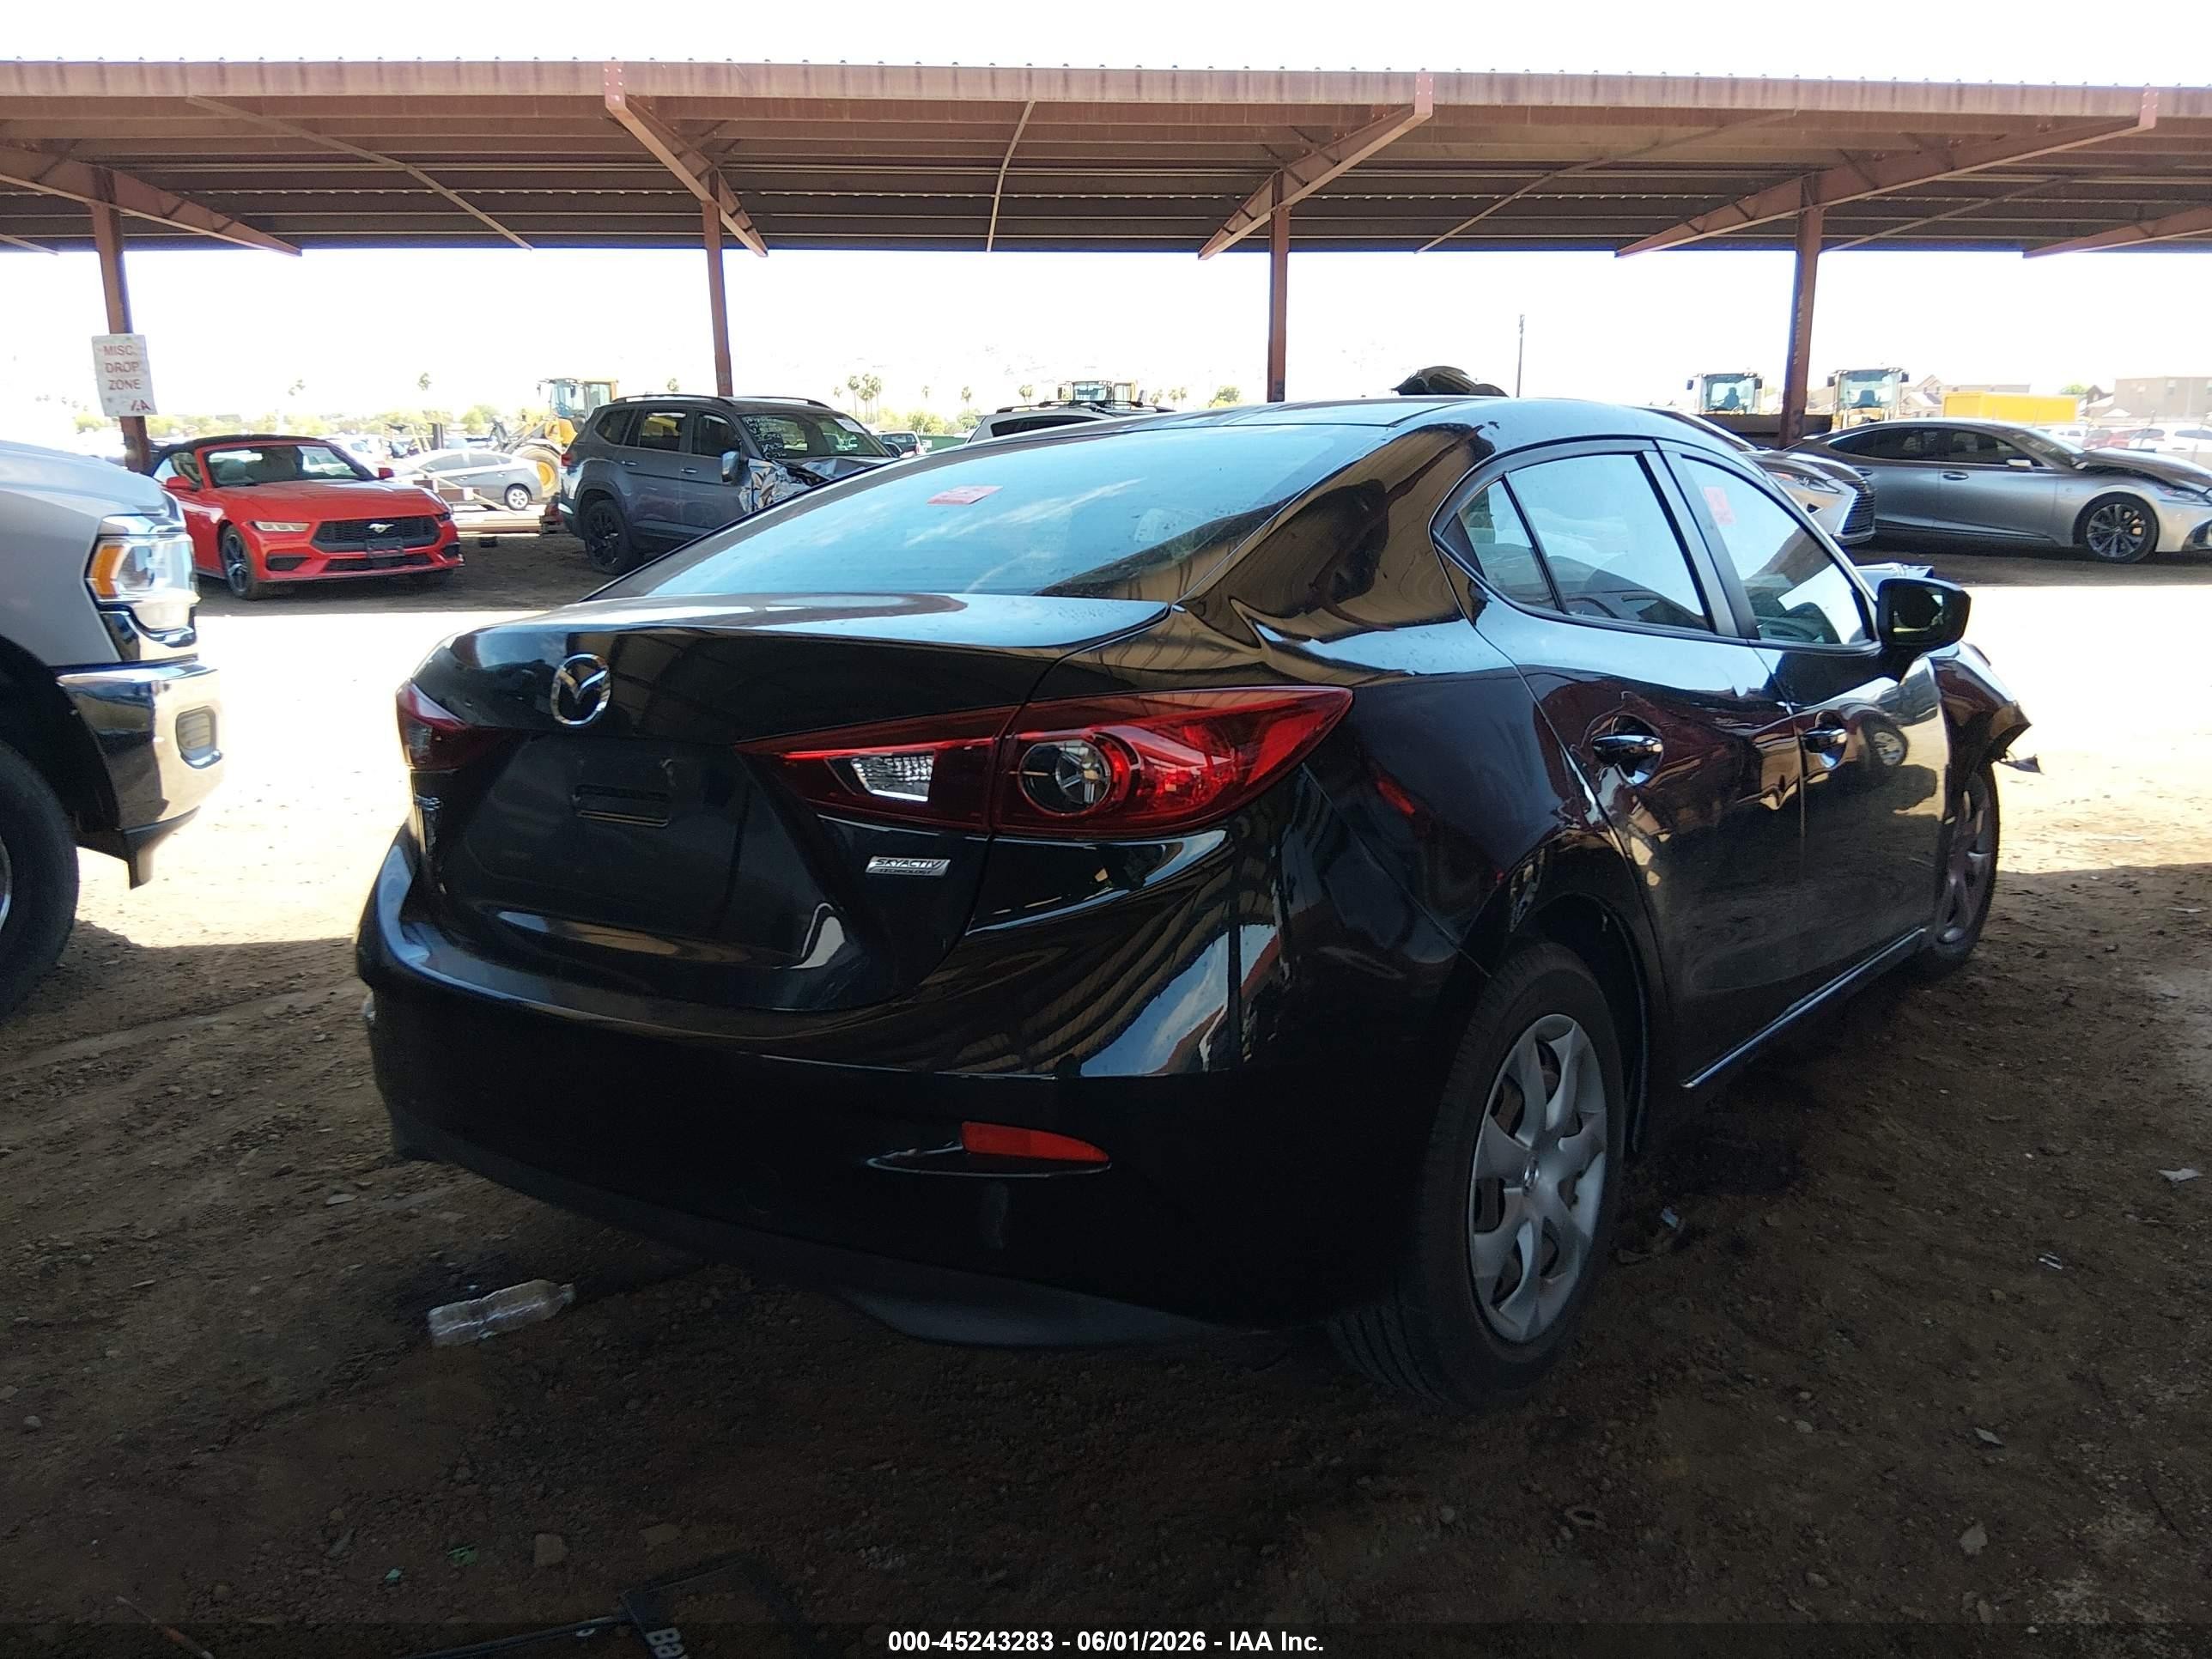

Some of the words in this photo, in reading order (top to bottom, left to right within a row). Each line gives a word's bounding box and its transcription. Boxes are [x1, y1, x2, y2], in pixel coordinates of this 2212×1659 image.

[105, 362, 139, 373] DROP
[108, 379, 142, 390] ZONE
[875, 858, 943, 868] SKYACTIV
